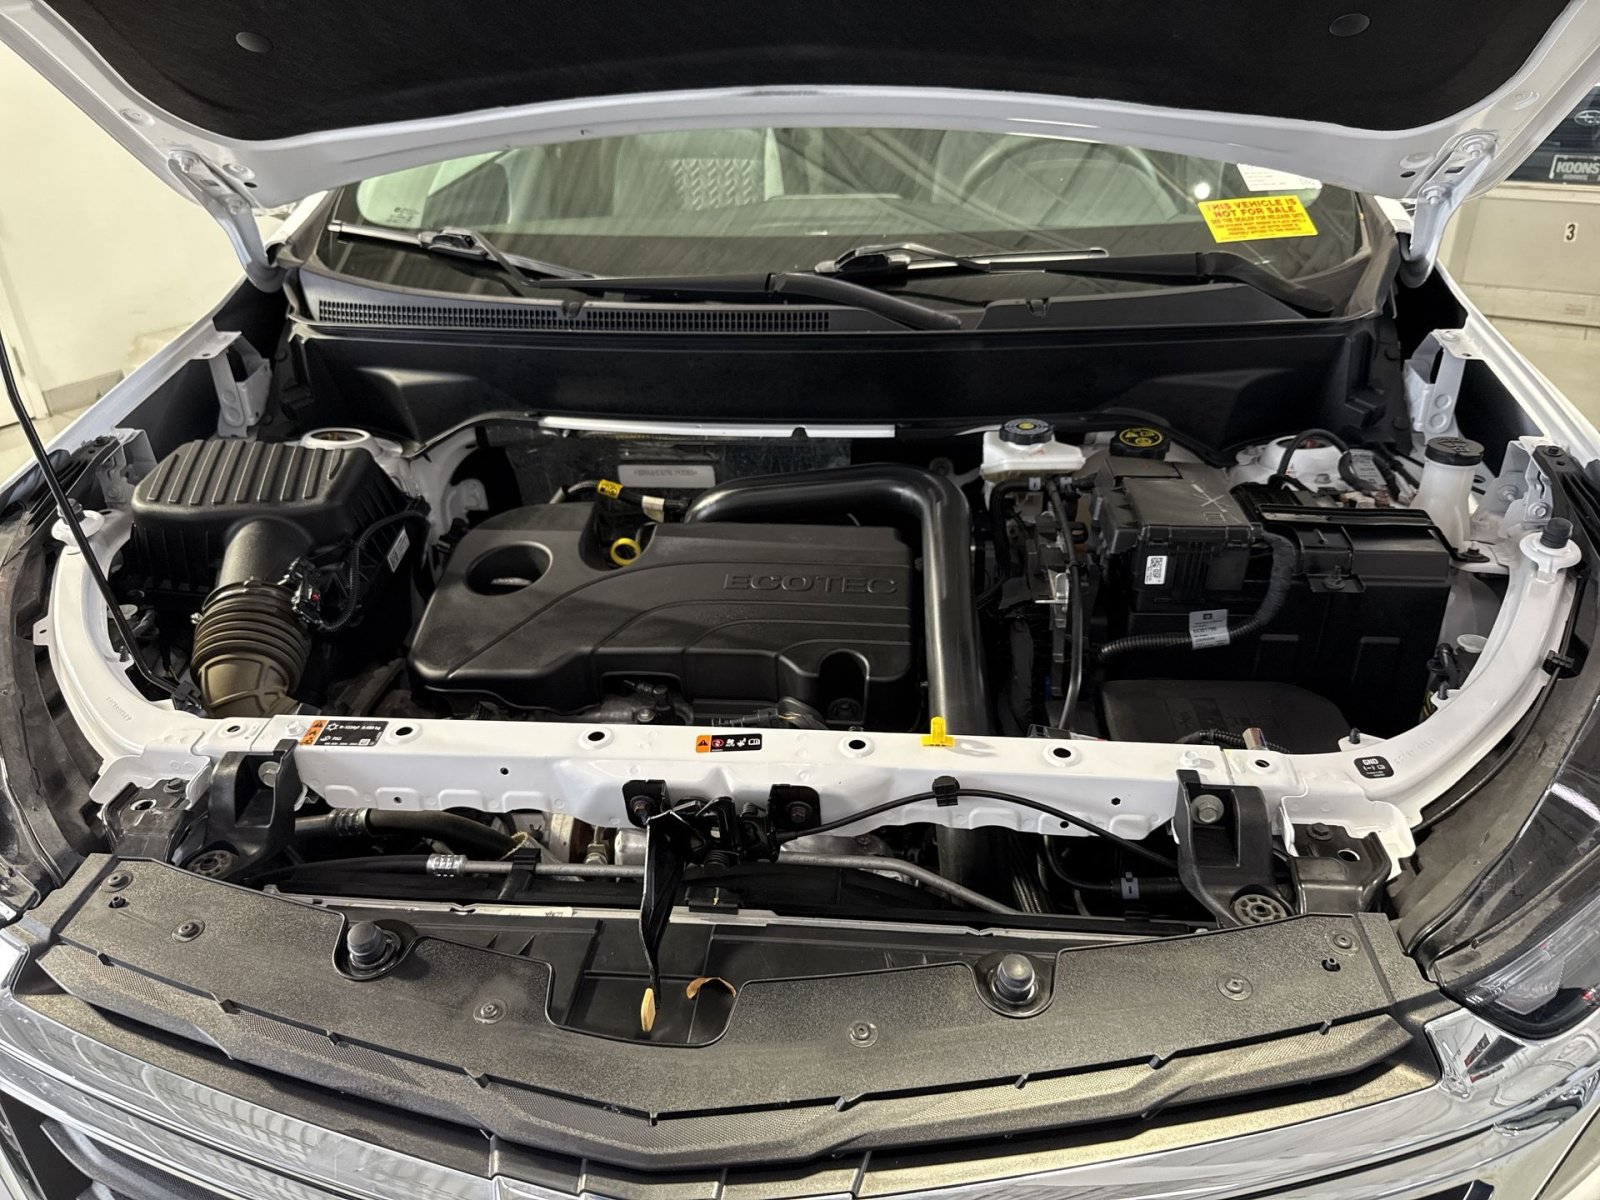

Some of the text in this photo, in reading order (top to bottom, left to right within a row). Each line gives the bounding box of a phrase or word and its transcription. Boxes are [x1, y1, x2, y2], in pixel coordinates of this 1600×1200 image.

[1556, 161, 1600, 174] KOONS
[1206, 198, 1297, 211] THIS VEHICLE IS
[1214, 205, 1297, 218] NOT FOR SALE
[1566, 224, 1575, 241] 3
[723, 573, 898, 594] ECOTEC
[1361, 758, 1379, 766] GND
